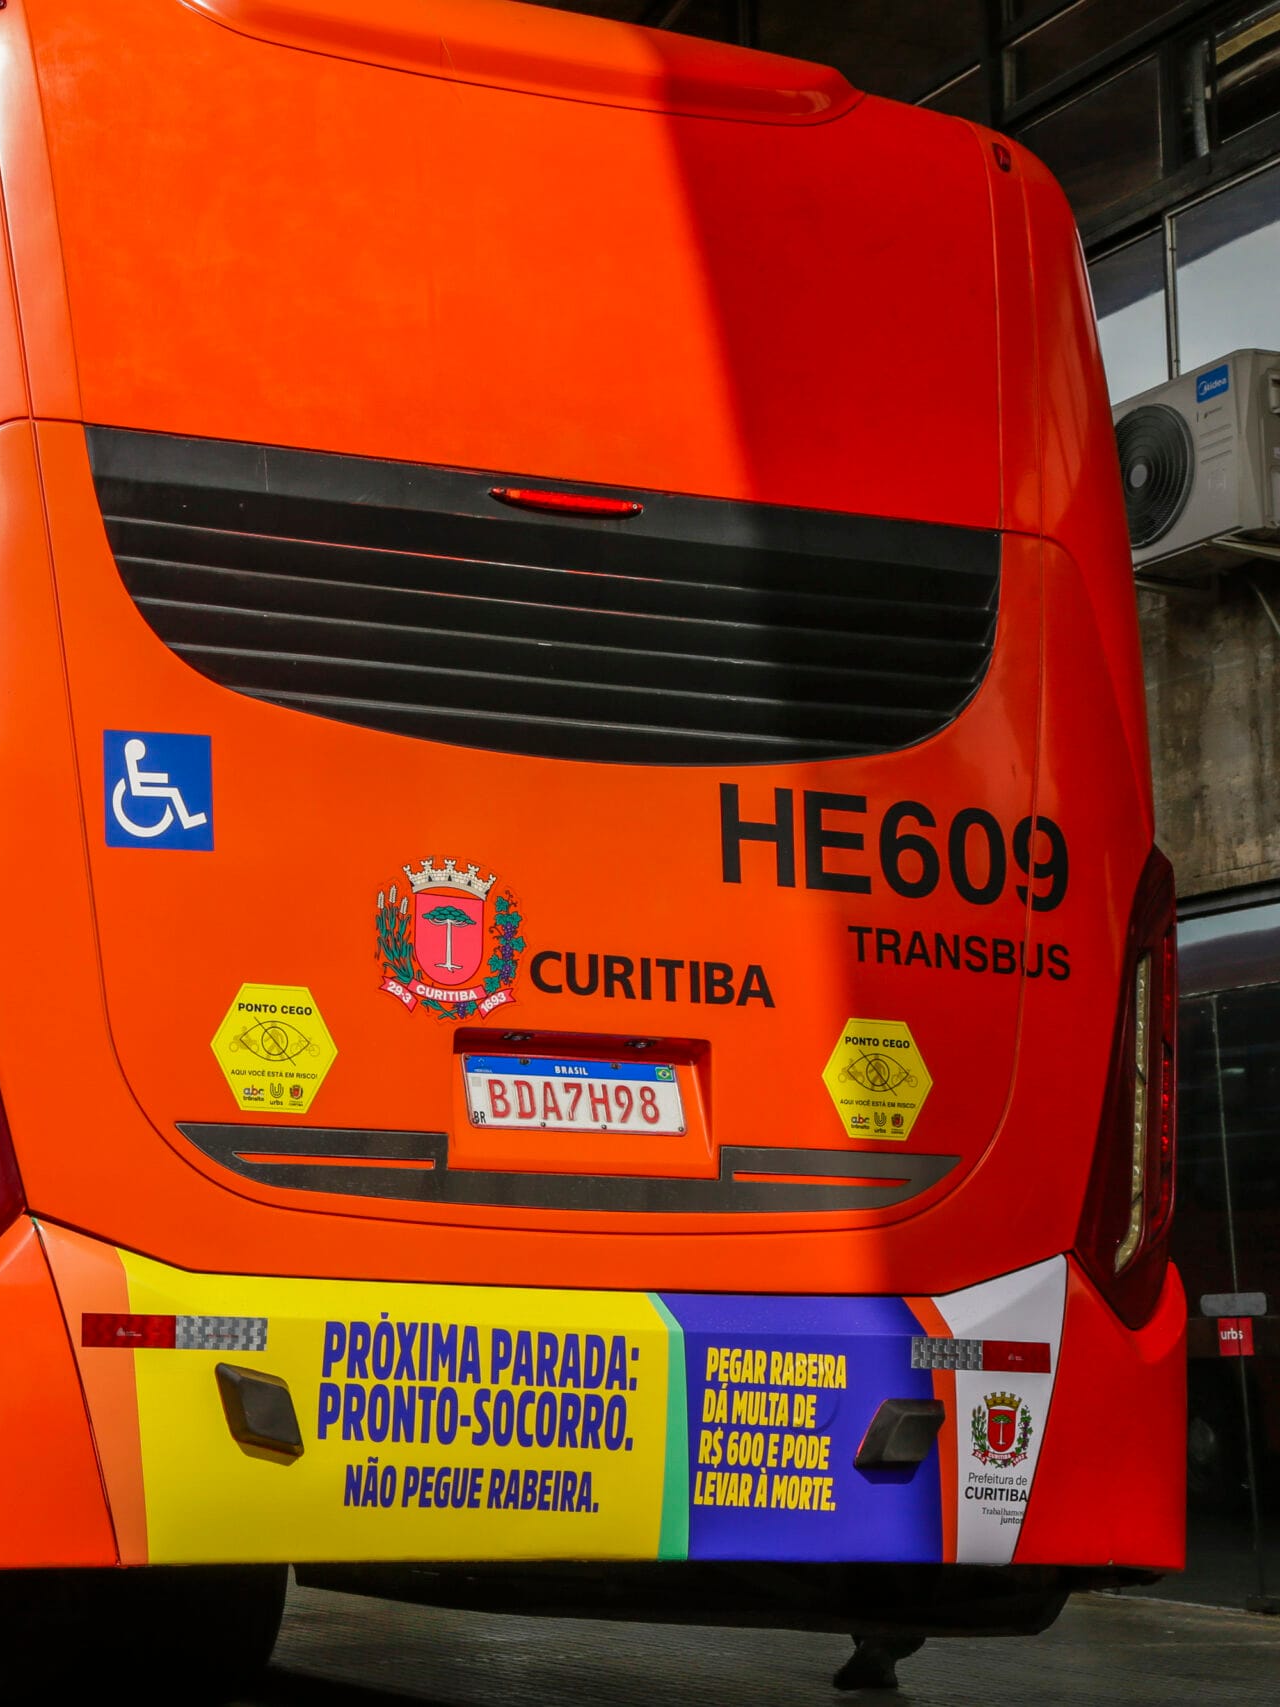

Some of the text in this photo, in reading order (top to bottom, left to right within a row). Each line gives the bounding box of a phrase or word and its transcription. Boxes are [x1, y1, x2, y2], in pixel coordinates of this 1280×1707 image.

[719, 782, 1069, 912] HE609
[848, 925, 1070, 981] TRANSBUS
[415, 984, 477, 1001] CURITIBA
[530, 950, 776, 1008] CURITIBA
[238, 1002, 313, 1016] PONTO CEGO
[480, 991, 507, 1013] 1693
[845, 1036, 910, 1049] PONTO CEGO
[554, 1065, 589, 1076] BRASIL
[473, 1111, 487, 1124] BR
[487, 1079, 660, 1124] BDA7H98
[321, 1312, 640, 1391] PRÓXIMA PARADA:
[1220, 1327, 1244, 1340] urbs
[705, 1347, 847, 1389] PEGAR RABEIRA
[317, 1382, 634, 1452] PRONTO-SOCORRO.
[702, 1382, 816, 1429] DÁ MULTA DE
[698, 1427, 831, 1471] R$ 600 E PODE
[343, 1456, 599, 1513] NÃO PEGUE RABEIRA.
[693, 1467, 836, 1512] LEVAR À MORTE.
[964, 1486, 1028, 1502] CURITIBA
[968, 1472, 1028, 1486] Prefeitura de
[1000, 1516, 1022, 1525] junto
